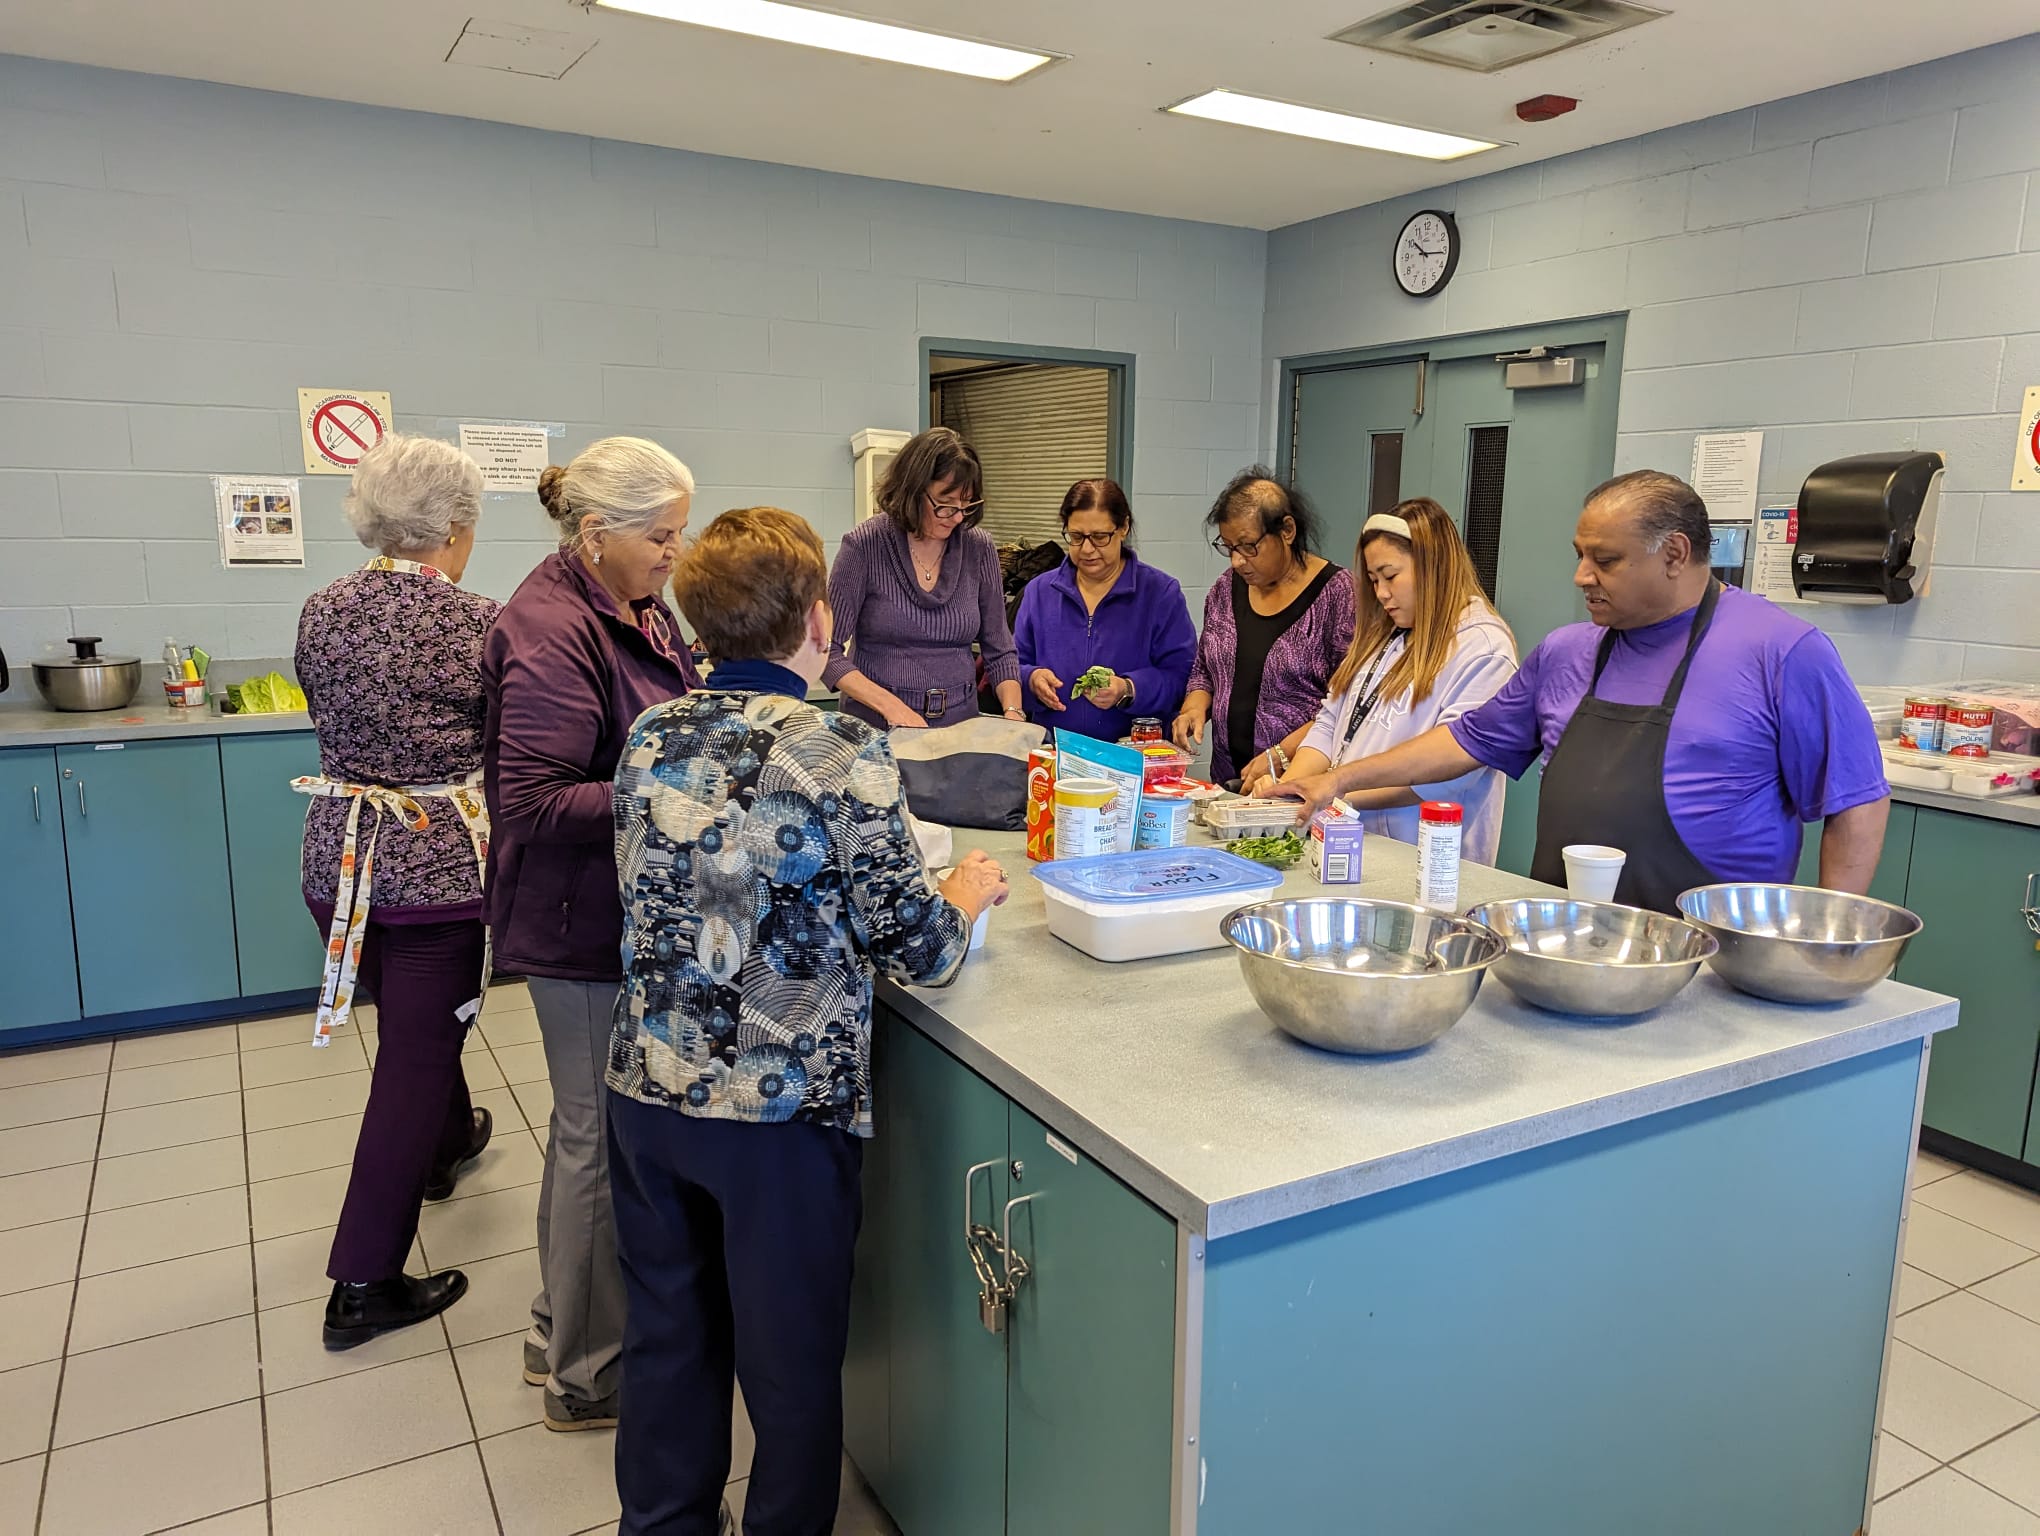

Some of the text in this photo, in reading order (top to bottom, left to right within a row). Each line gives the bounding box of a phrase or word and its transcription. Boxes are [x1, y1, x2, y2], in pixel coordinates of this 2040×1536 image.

[315, 394, 357, 411] SCARBOROUGH
[2026, 421, 2036, 436] CITY
[320, 453, 347, 469] MAXIMUM
[1366, 692, 1378, 709] STAFF
[1352, 715, 1363, 730] STAFF
[1960, 735, 1984, 743] POLPA
[1093, 824, 1113, 833] BREAD
[1138, 819, 1167, 829] BioBest
[1150, 872, 1220, 887] FLOUR
